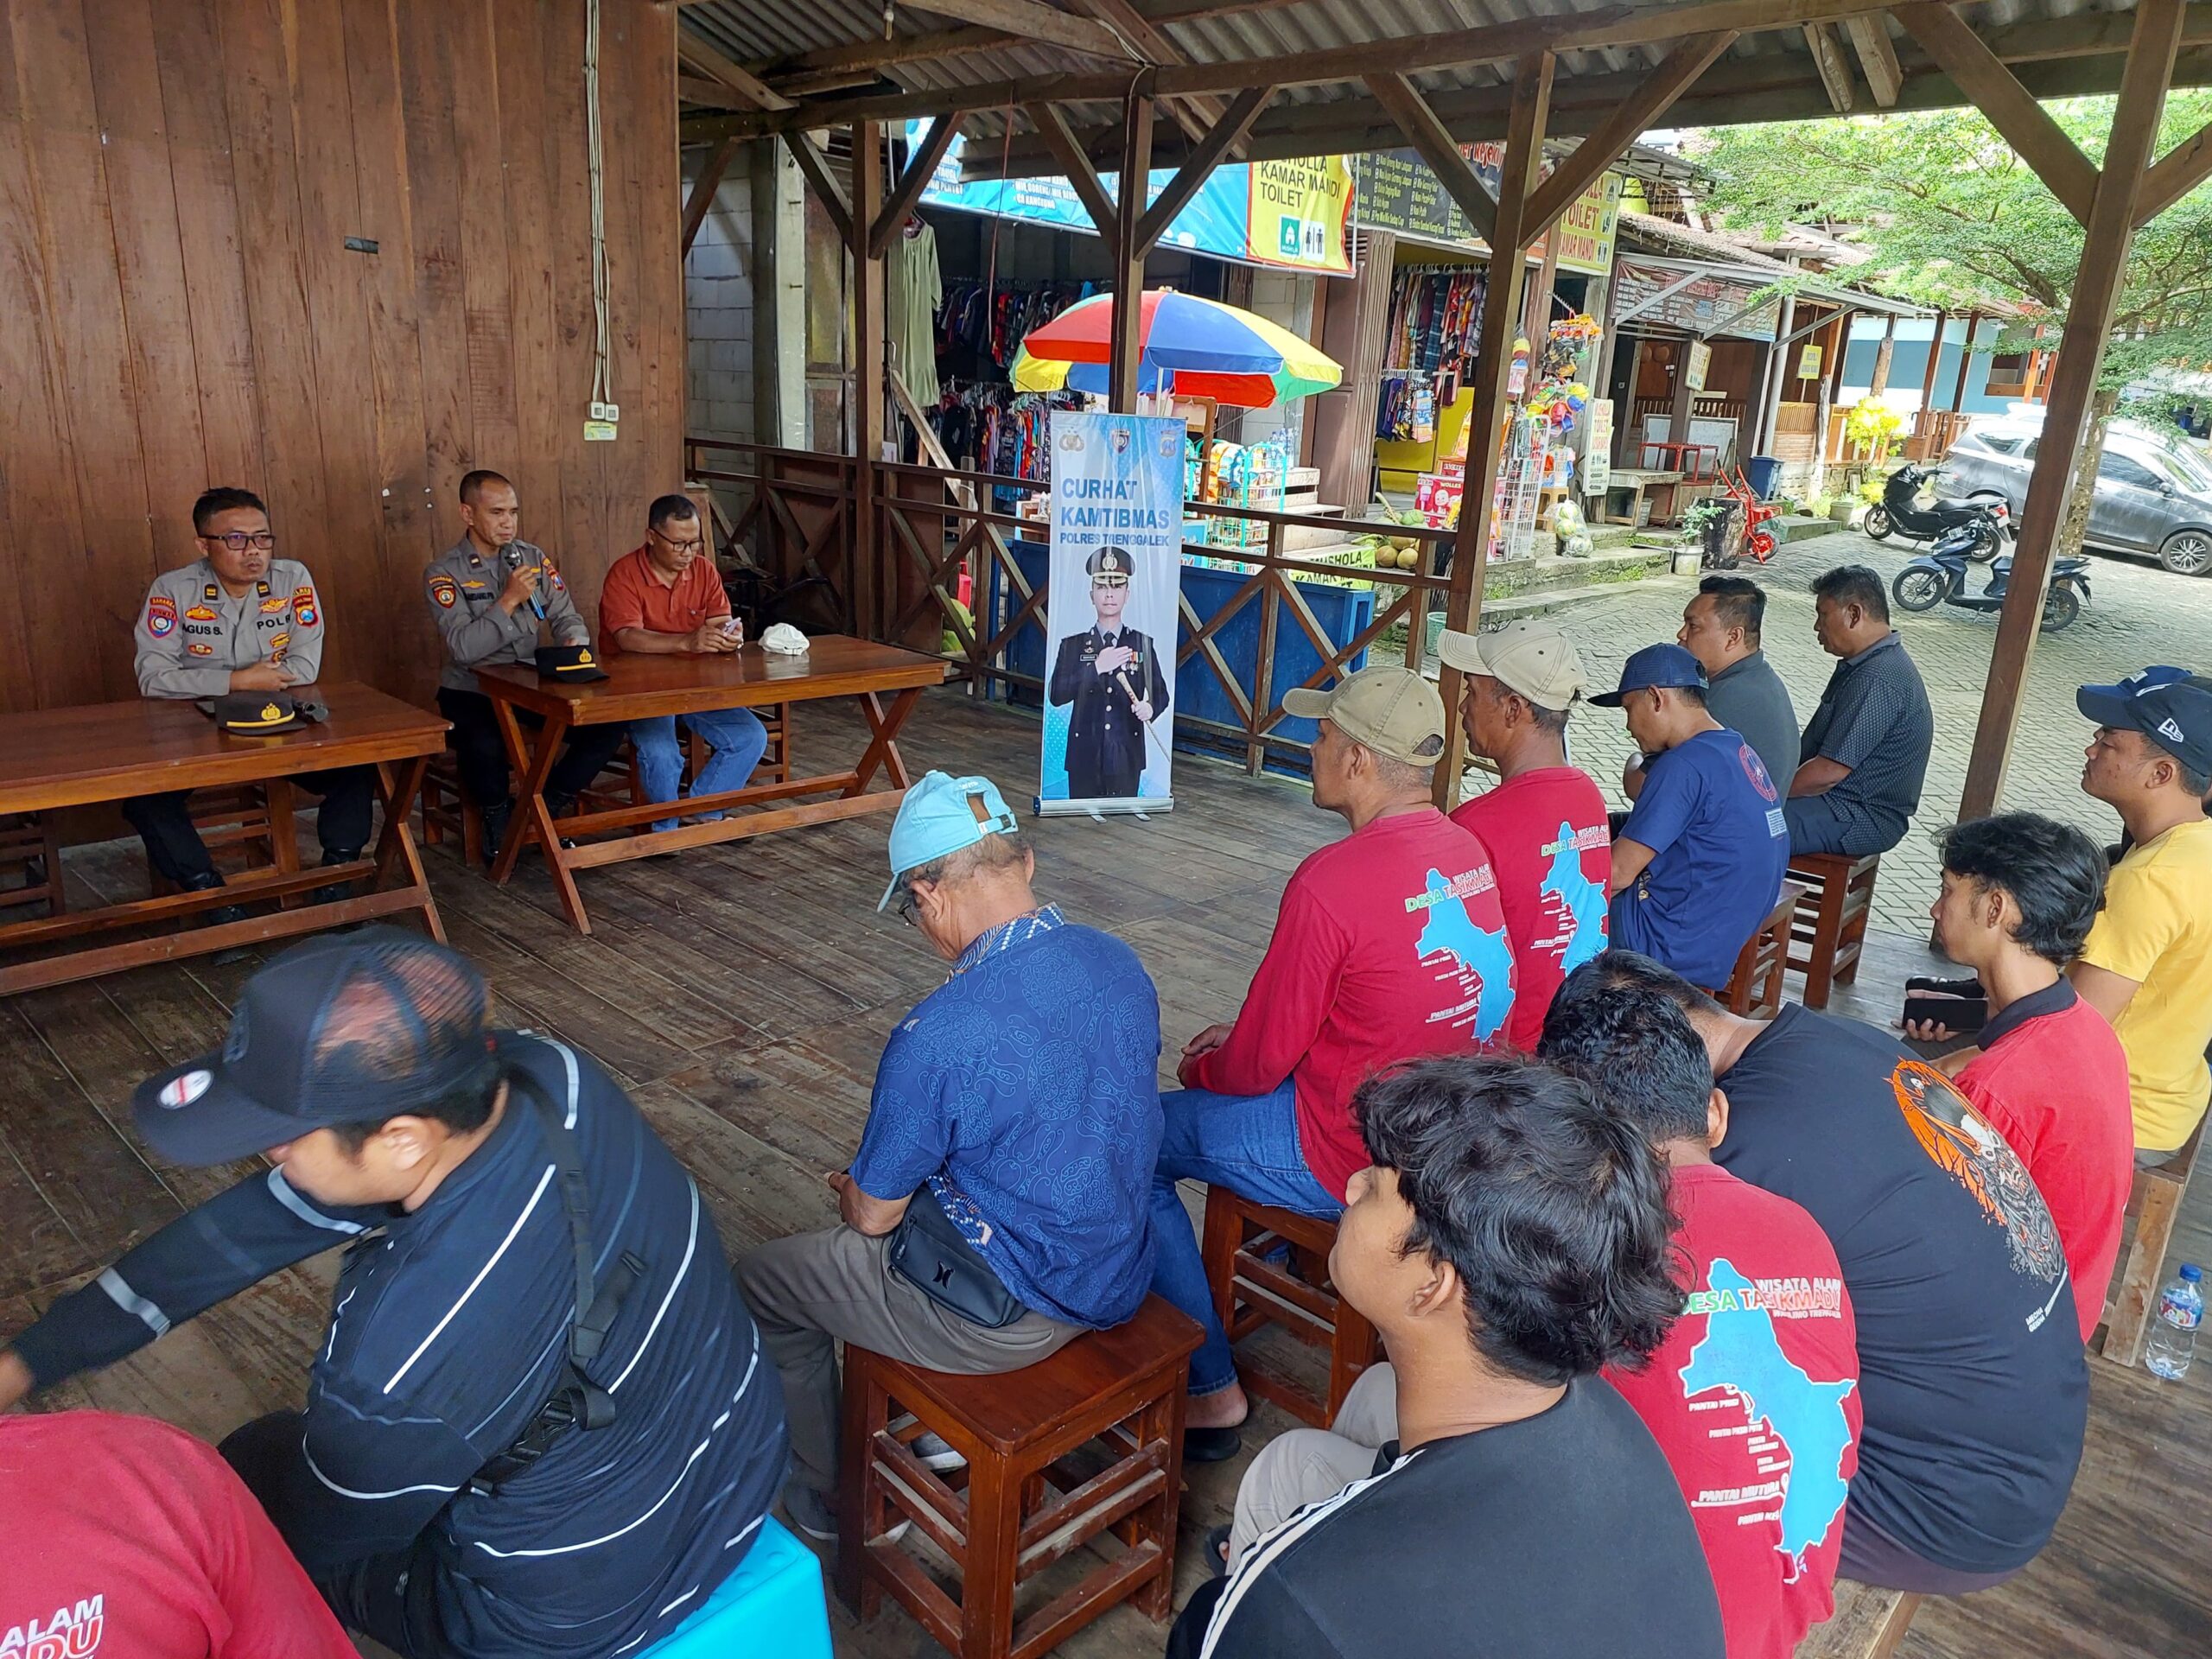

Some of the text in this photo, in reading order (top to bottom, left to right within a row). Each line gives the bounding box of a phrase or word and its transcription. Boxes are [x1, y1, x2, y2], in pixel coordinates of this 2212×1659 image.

[1261, 162, 1340, 200] KAMAR MANDI
[1260, 181, 1303, 209] TOILET
[1561, 201, 1599, 231] TOILET
[1062, 478, 1137, 500] CURHAT
[1061, 506, 1170, 529] KAMTIBMAS
[1059, 532, 1170, 546] POLRES TRENGGALEK
[181, 623, 211, 634] AGUS
[1541, 839, 1567, 856] DESA
[1452, 868, 1478, 884] WISATA
[1405, 889, 1444, 912] DESA
[1755, 1277, 1841, 1294] WISATA ALAM
[1683, 1288, 1841, 1315] ESA TASIKMADU
[2025, 1306, 2044, 1325] MECHA
[1688, 1401, 1719, 1412] PANTAI
[1698, 1488, 1740, 1503] PANTAI
[0, 1594, 103, 1654] ALAM
